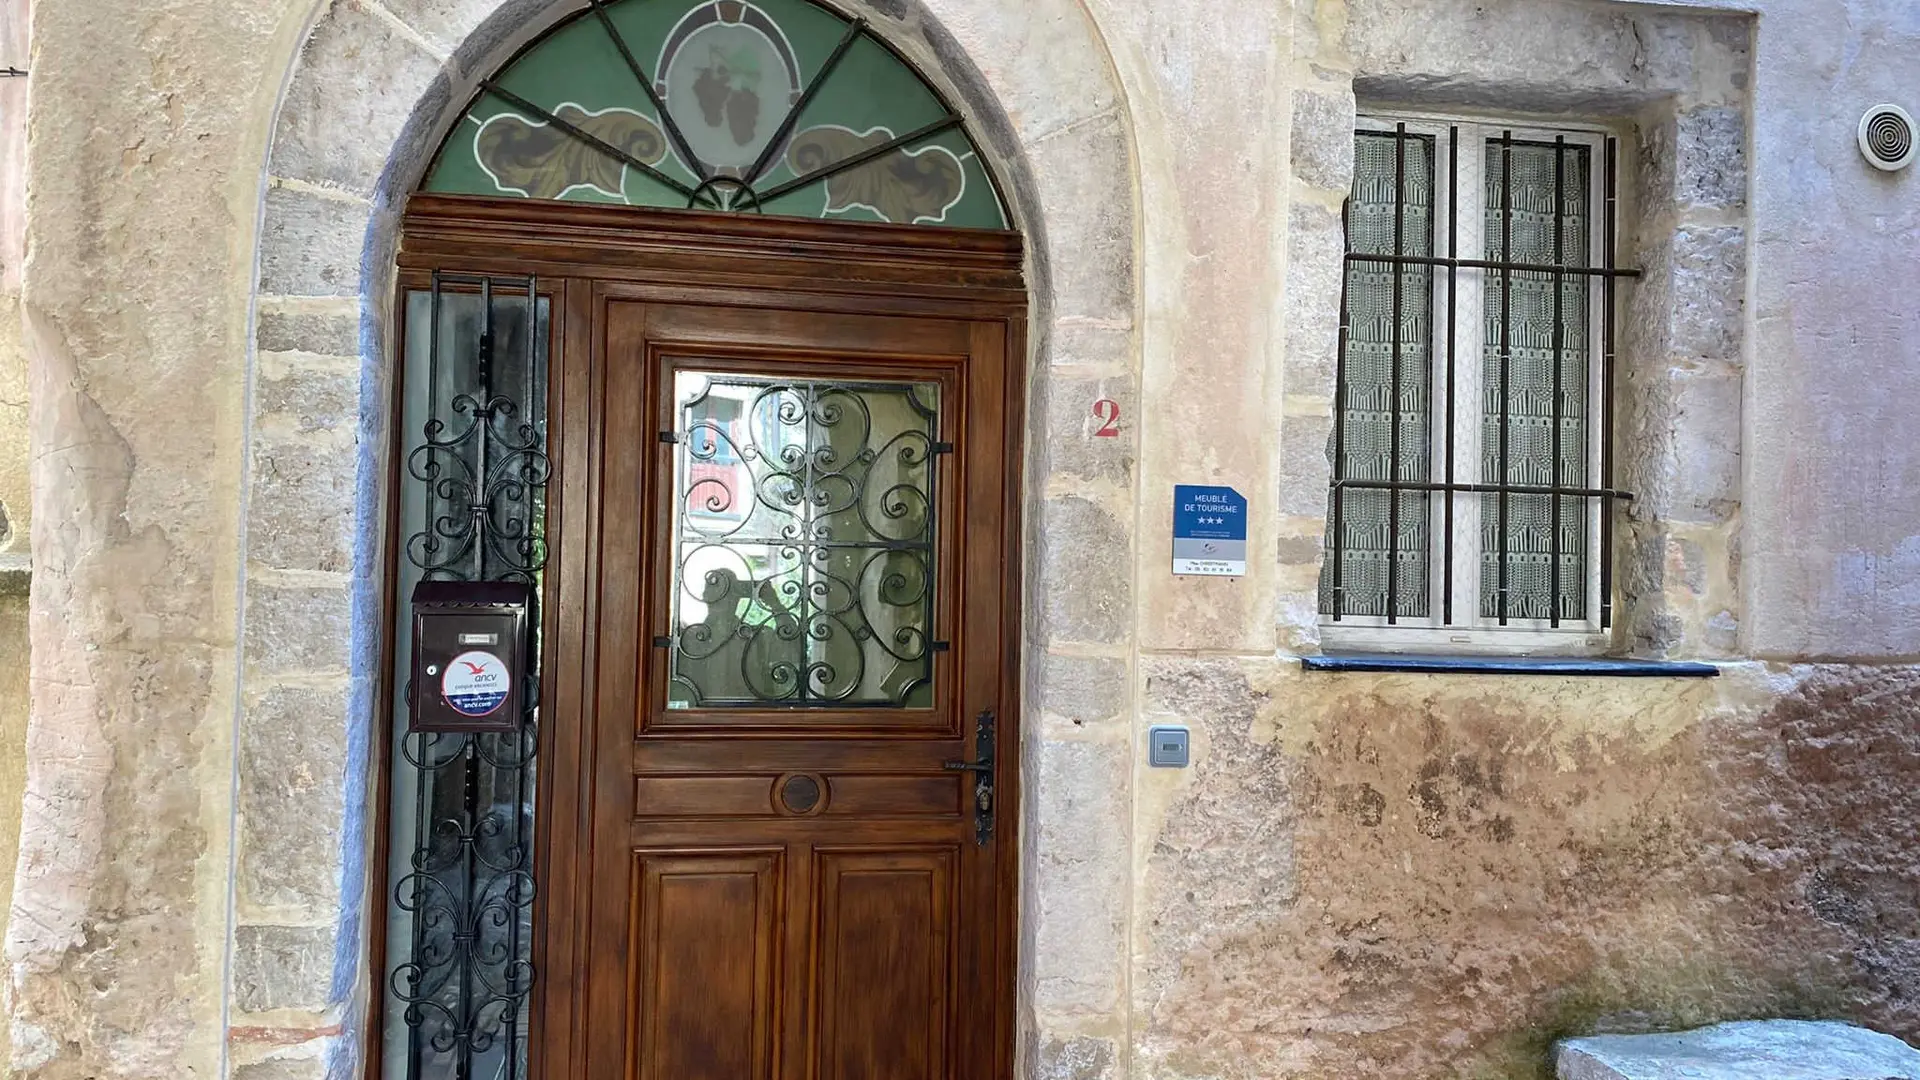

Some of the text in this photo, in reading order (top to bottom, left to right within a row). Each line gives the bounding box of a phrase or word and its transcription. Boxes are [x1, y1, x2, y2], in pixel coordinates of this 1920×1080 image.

[1093, 399, 1120, 437] 2
[1184, 504, 1238, 513] DE TOURISME
[474, 674, 497, 682] ancv
